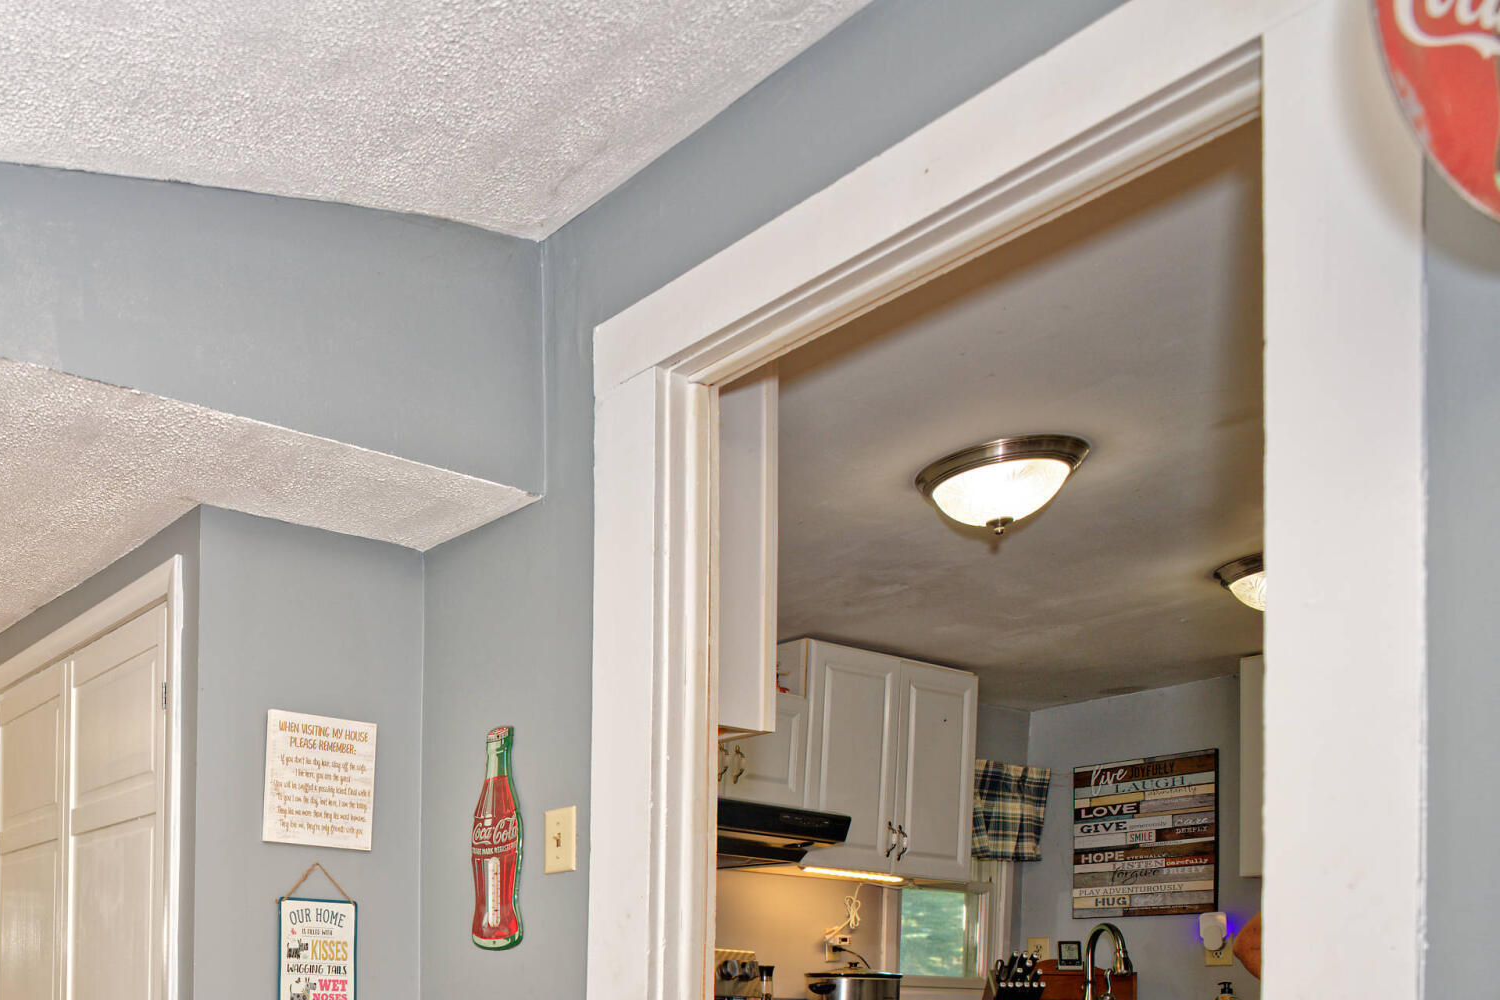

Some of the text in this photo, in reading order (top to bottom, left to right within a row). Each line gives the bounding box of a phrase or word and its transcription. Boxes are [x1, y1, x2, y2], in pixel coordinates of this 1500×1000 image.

[279, 720, 369, 743] WHEN VISITING MY HOUSE
[290, 736, 357, 755] PLEASE REMEMBER:
[1129, 761, 1175, 779] JOYFULLY
[1114, 776, 1186, 793] LAUGH
[1080, 802, 1138, 819] LOVE
[472, 816, 518, 845] Coca-Cola
[1080, 821, 1127, 834] GIVE
[1175, 826, 1210, 835] DEEPLY
[1129, 831, 1153, 843] SMILE
[1081, 850, 1125, 864] HOPE
[1112, 858, 1209, 871] LISTEN carefully
[1079, 883, 1184, 897] PLAY ADVENTUROUSLY
[1095, 896, 1127, 907] HUG
[289, 908, 346, 928] OUR HOME
[310, 939, 348, 961] KISSES
[286, 963, 347, 975] WAGGING TAILS
[318, 978, 348, 992] WET
